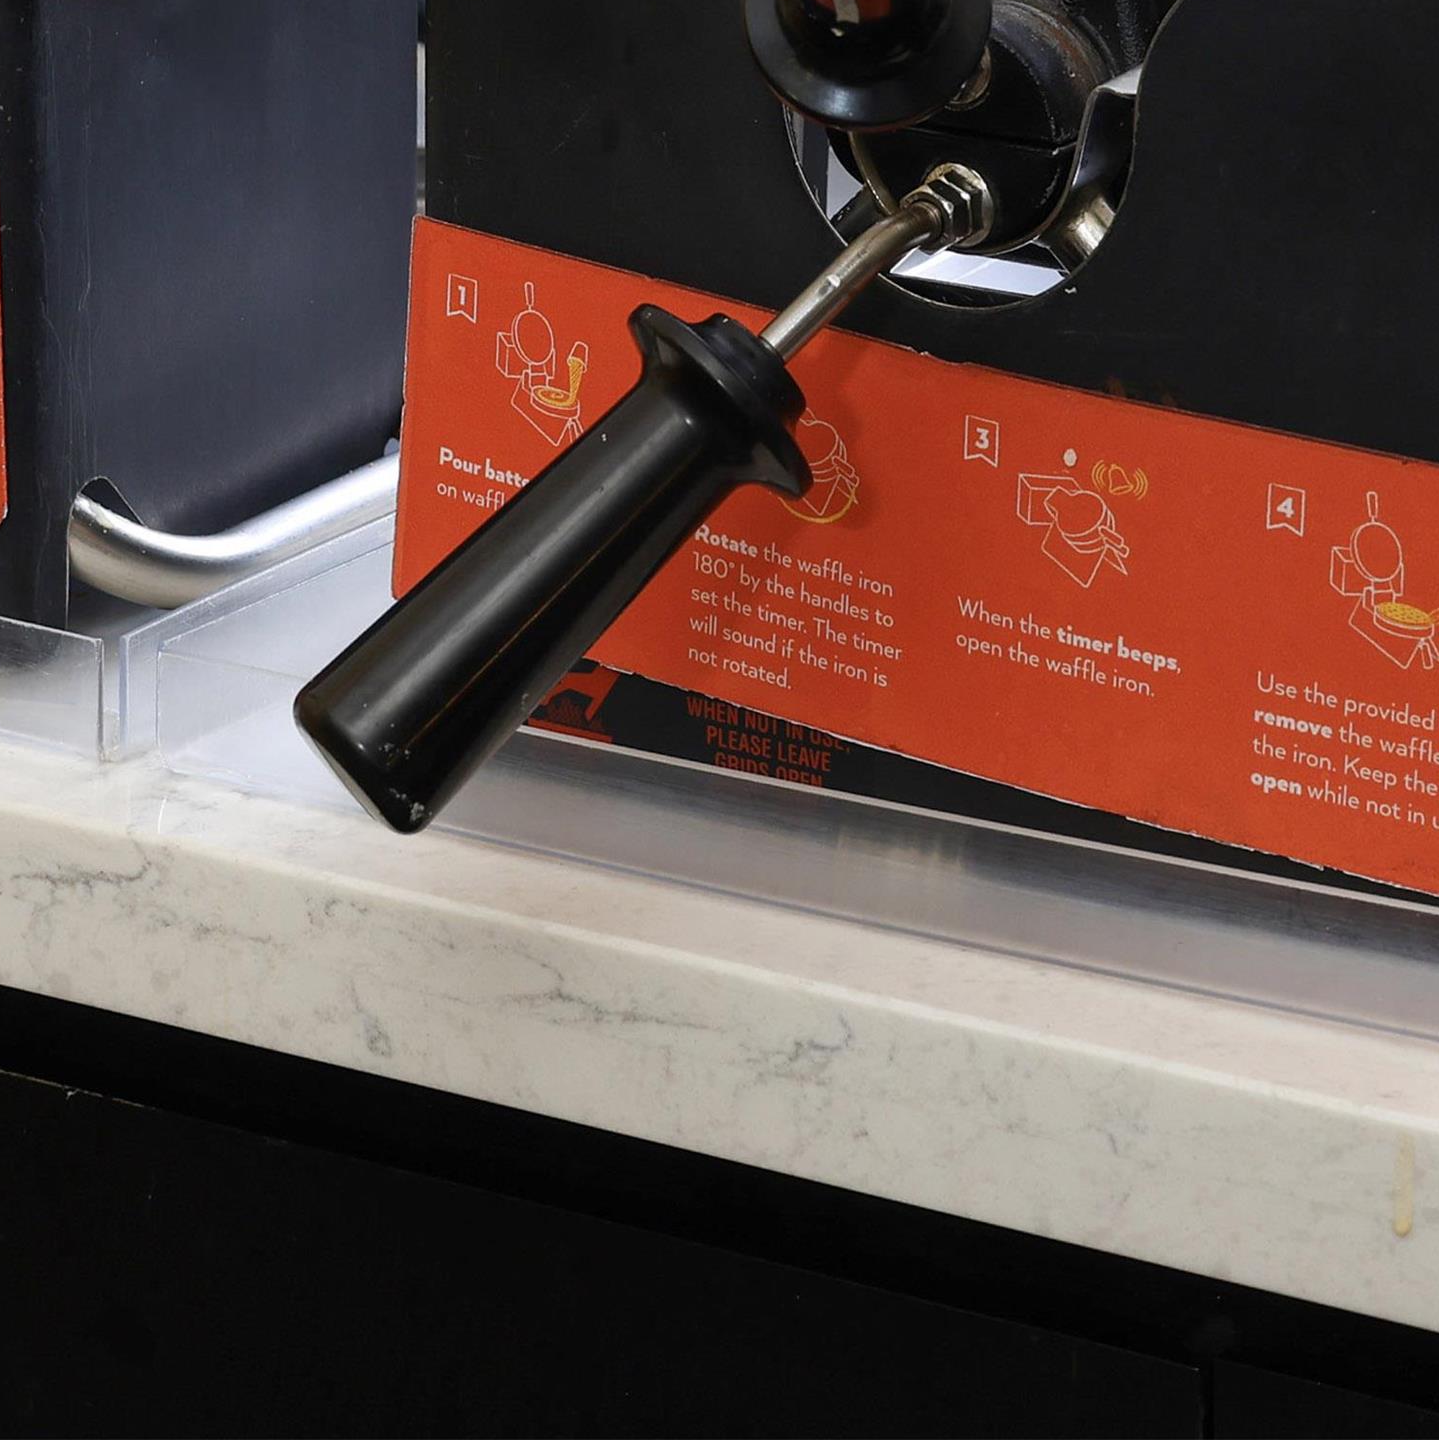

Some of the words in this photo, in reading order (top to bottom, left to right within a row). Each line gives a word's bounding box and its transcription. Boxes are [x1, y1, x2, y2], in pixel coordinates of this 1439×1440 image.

[439, 446, 482, 476] Pour
[976, 427, 990, 449] 3
[437, 482, 457, 499] on
[1277, 497, 1295, 518] 4
[694, 523, 759, 558] Rotate
[763, 542, 792, 568] the
[797, 558, 853, 586] waffle
[859, 570, 894, 597] iron
[740, 563, 761, 593] by
[766, 574, 796, 600] the
[800, 582, 870, 621] handles
[875, 609, 894, 628] to
[690, 615, 718, 636] will
[722, 627, 777, 654] sound
[781, 638, 794, 659] if
[799, 644, 829, 670] the
[834, 655, 868, 682] iron
[873, 665, 888, 687] is
[691, 588, 719, 607] set
[723, 592, 752, 616] the
[758, 603, 807, 634] timer.
[812, 617, 848, 645] The
[852, 633, 903, 660] timer
[957, 596, 1014, 630] When
[1019, 613, 1052, 639] the
[1056, 625, 1114, 656] timer
[1117, 636, 1182, 674] beeps,
[688, 647, 718, 668] not
[723, 658, 792, 690] rotated.
[956, 634, 1002, 658] open
[1008, 641, 1040, 667] the
[1046, 656, 1107, 686] waffle
[1112, 668, 1155, 698] iron.
[687, 695, 738, 725] WHEN
[1257, 670, 1298, 699] Use
[1303, 681, 1338, 708] the
[1344, 698, 1436, 731] provided
[706, 725, 771, 758] PLEASE
[778, 741, 831, 772] LEAVE
[1254, 708, 1334, 740] remove
[1339, 723, 1373, 749] the
[1252, 734, 1287, 761] the
[1293, 744, 1337, 772] iron.
[1343, 755, 1398, 790] Keep
[1404, 769, 1439, 797] the
[1250, 771, 1303, 796] open
[1307, 781, 1361, 810] while
[1366, 798, 1401, 820] not
[1407, 804, 1426, 825] in
